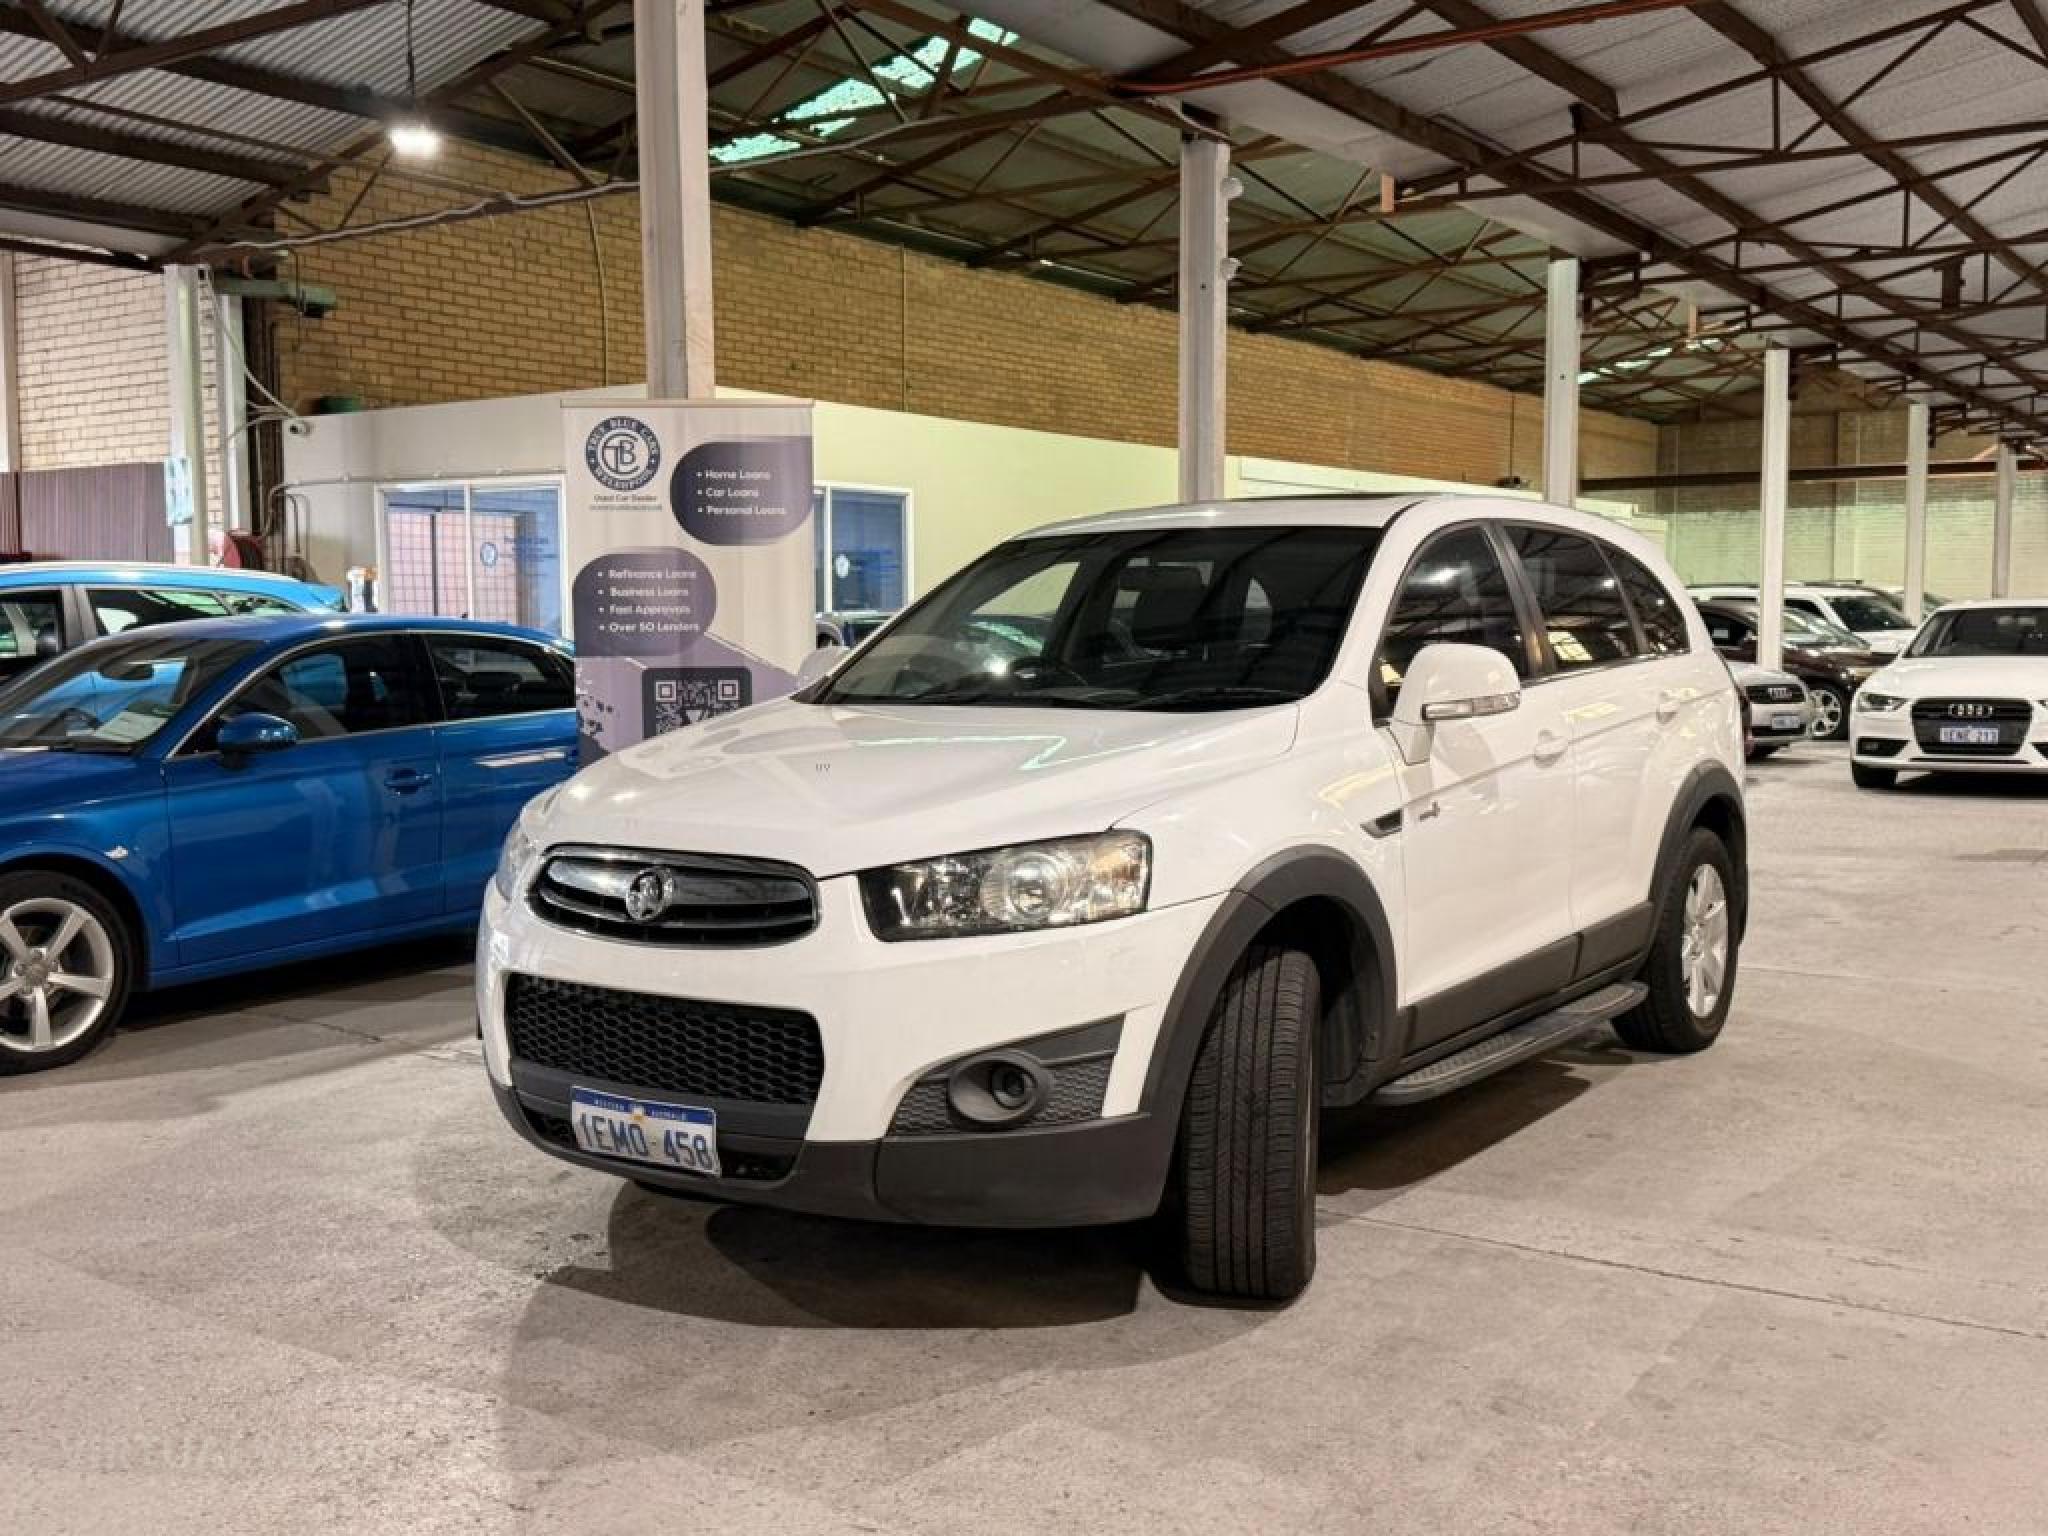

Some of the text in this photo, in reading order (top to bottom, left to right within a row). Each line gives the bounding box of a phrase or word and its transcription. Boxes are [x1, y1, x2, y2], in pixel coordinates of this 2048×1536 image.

[705, 469, 771, 479] Home Loans
[705, 487, 759, 497] Car Loans
[706, 505, 786, 515] Personal Loans
[609, 567, 697, 579] Refinance Loans
[609, 586, 689, 597] Business Loans
[635, 604, 691, 617] Approvals
[609, 621, 700, 632] Over 50 Lenders
[663, 1129, 713, 1171] 458
